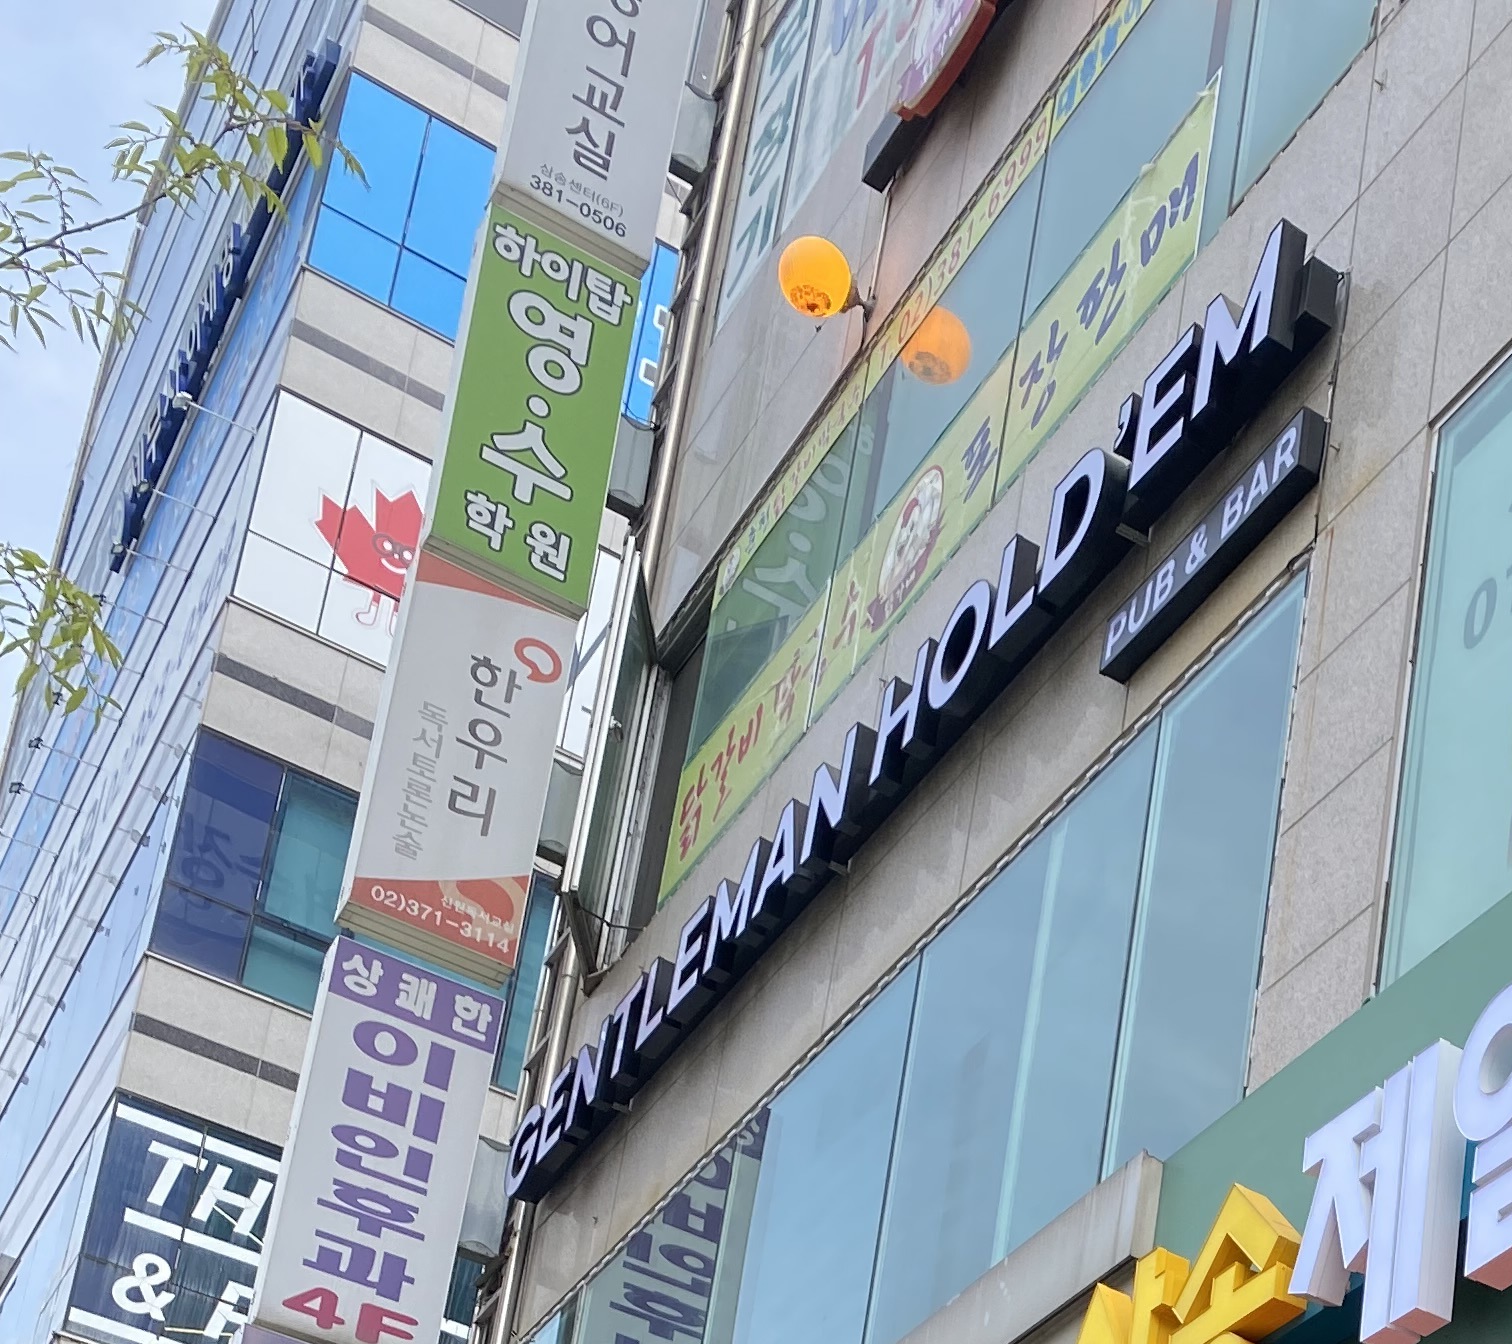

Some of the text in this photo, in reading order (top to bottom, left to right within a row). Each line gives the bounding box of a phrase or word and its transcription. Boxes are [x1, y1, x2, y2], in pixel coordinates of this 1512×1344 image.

[529, 173, 628, 239] 381-0506
[491, 220, 634, 329] 하이탑
[464, 489, 572, 584] 학원
[1105, 425, 1298, 660] PUB & BAR
[446, 653, 524, 838] 한우리
[504, 722, 866, 1202] GENTLEMAN
[866, 216, 1298, 790] HOLD'EM
[393, 700, 450, 862] 독서토론논술
[678, 702, 764, 862] 닭갈비
[370, 884, 511, 954] 02)371-3114
[342, 953, 494, 1042] 상쾌한
[302, 1019, 457, 1303] 이비인후과
[111, 1251, 176, 1322] &
